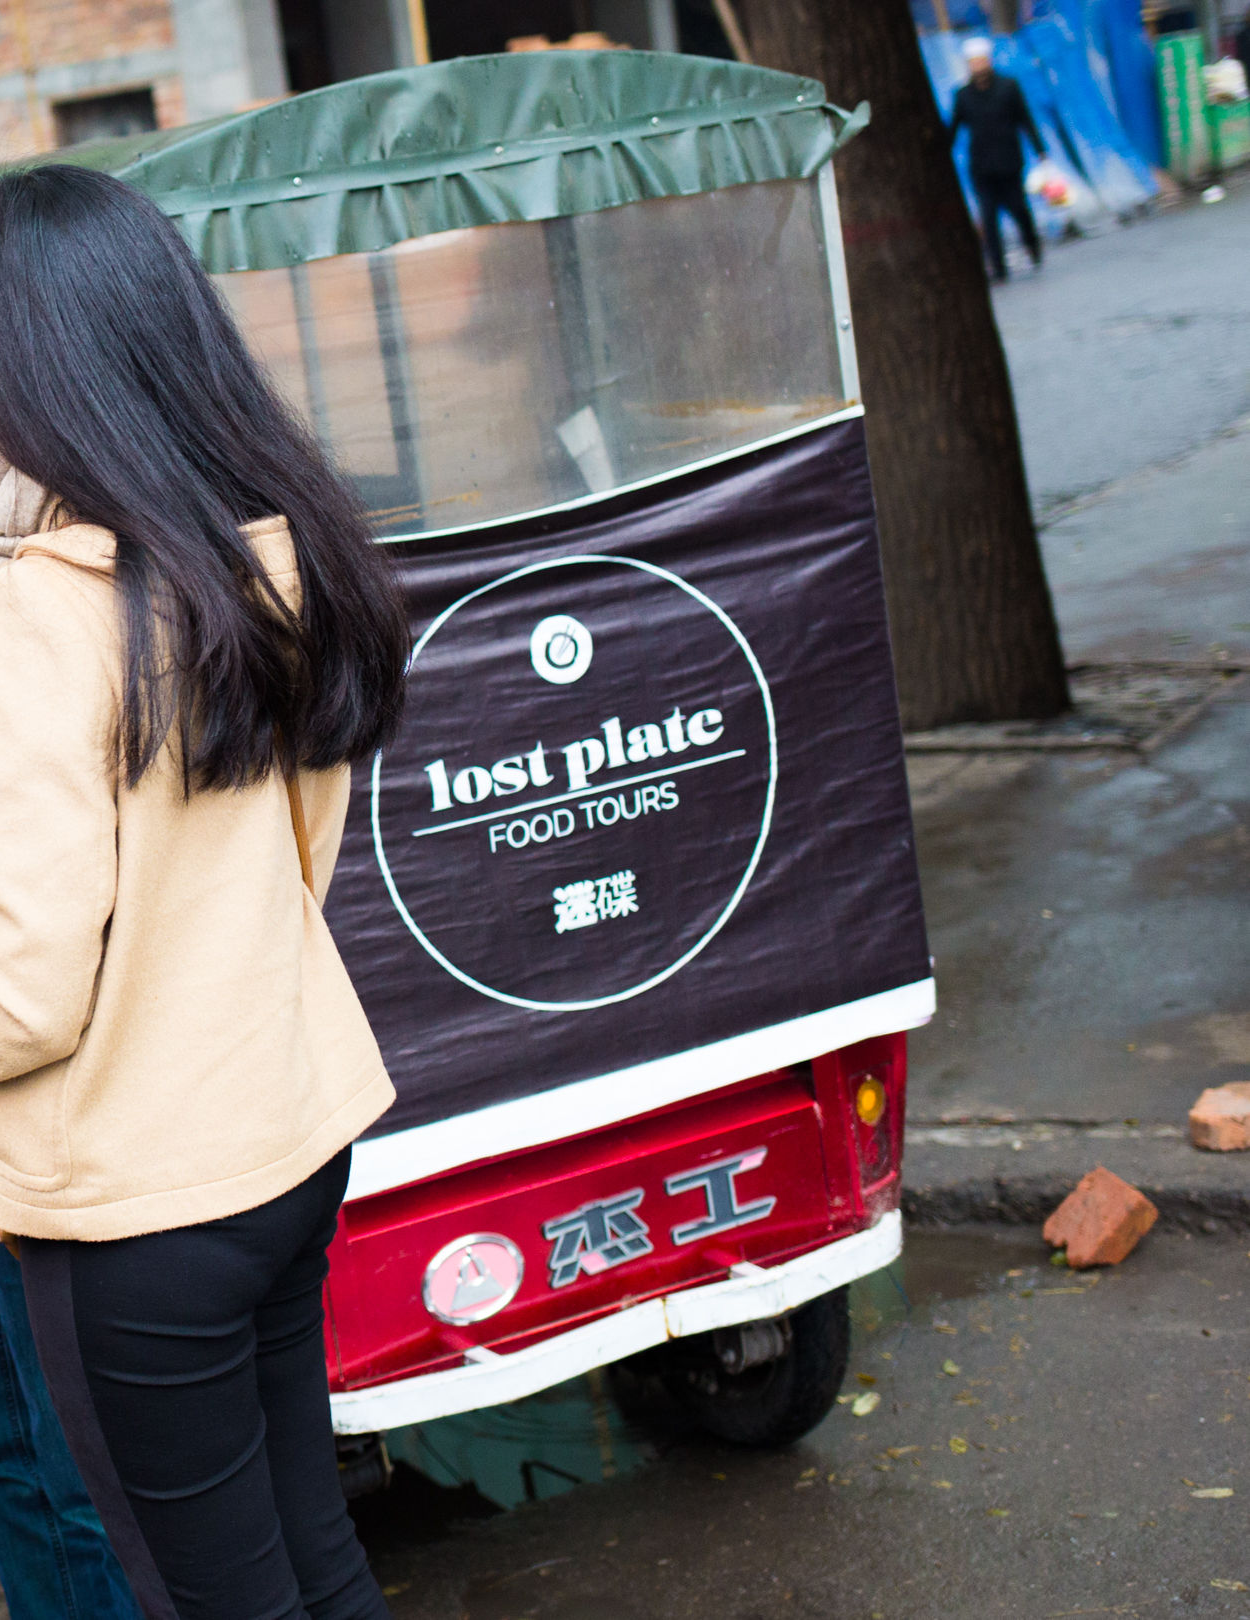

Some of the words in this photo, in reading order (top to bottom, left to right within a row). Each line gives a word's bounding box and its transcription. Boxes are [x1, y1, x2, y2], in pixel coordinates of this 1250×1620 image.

[424, 740, 554, 812] lost
[562, 707, 724, 792] plate
[488, 808, 575, 853] FOOD
[579, 780, 679, 829] TOURS
[541, 1146, 778, 1289] 杰工
